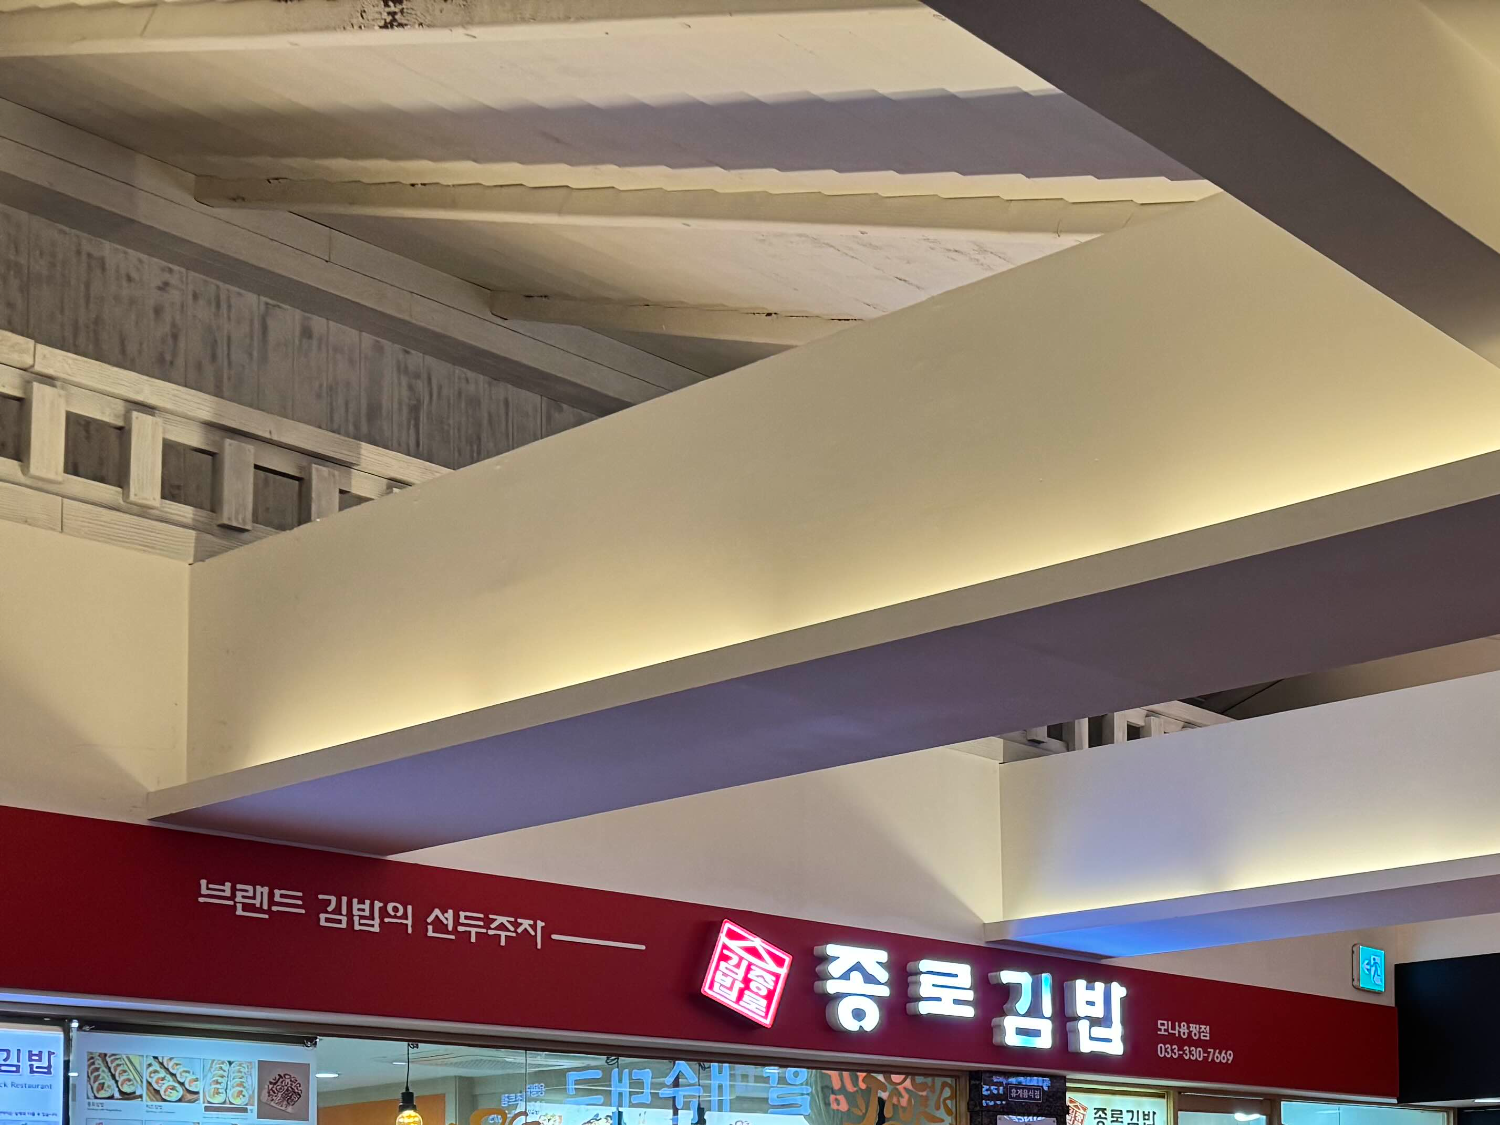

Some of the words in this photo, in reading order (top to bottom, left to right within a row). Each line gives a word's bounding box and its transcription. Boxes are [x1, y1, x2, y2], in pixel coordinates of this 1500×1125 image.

[198, 879, 306, 920] 브랜드
[318, 893, 415, 935] 김밥의
[427, 907, 546, 949] 선두주자
[816, 942, 1128, 1055] 종로김밥
[1157, 1018, 1211, 1041] 모나용평점
[1157, 1041, 1235, 1065] 033-330-7669
